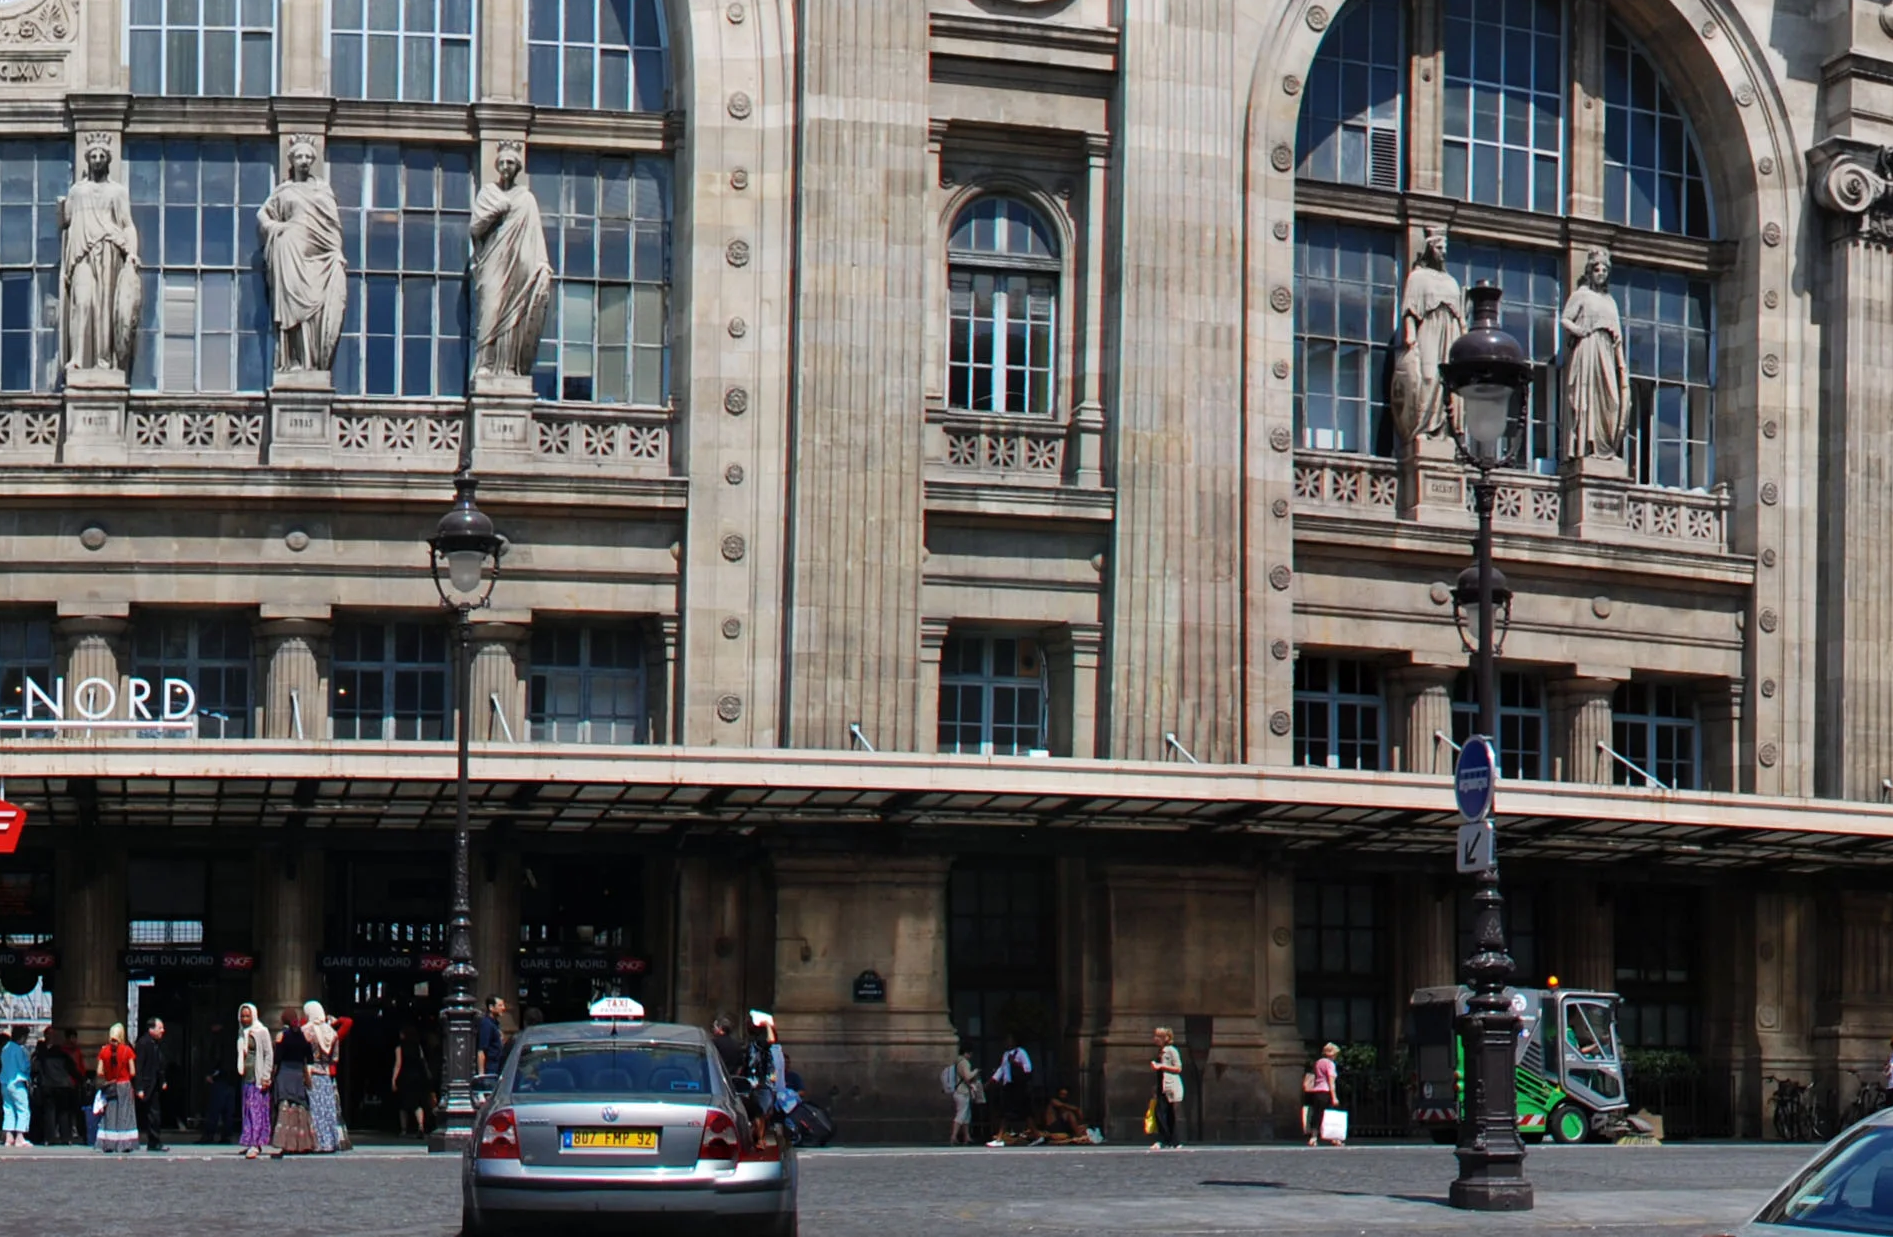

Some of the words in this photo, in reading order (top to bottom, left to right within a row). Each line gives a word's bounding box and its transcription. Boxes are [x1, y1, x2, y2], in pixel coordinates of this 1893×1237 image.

[26, 677, 197, 719] NORD
[24, 954, 55, 966] SNCF
[125, 955, 155, 965] GARE
[160, 955, 177, 965] DU
[181, 955, 214, 965] NORD
[223, 955, 254, 967] SNCF
[322, 956, 354, 967] GARE
[358, 956, 375, 967] DU
[378, 956, 411, 967] NORD
[421, 957, 448, 969] SNCF
[520, 959, 550, 970] GARE
[555, 959, 571, 970] DU
[575, 959, 607, 970] NORD
[616, 959, 646, 971] SNCF
[606, 999, 629, 1007] TAXI
[574, 1131, 596, 1145] 807
[605, 1131, 630, 1145] FMP
[637, 1131, 652, 1145] 92
